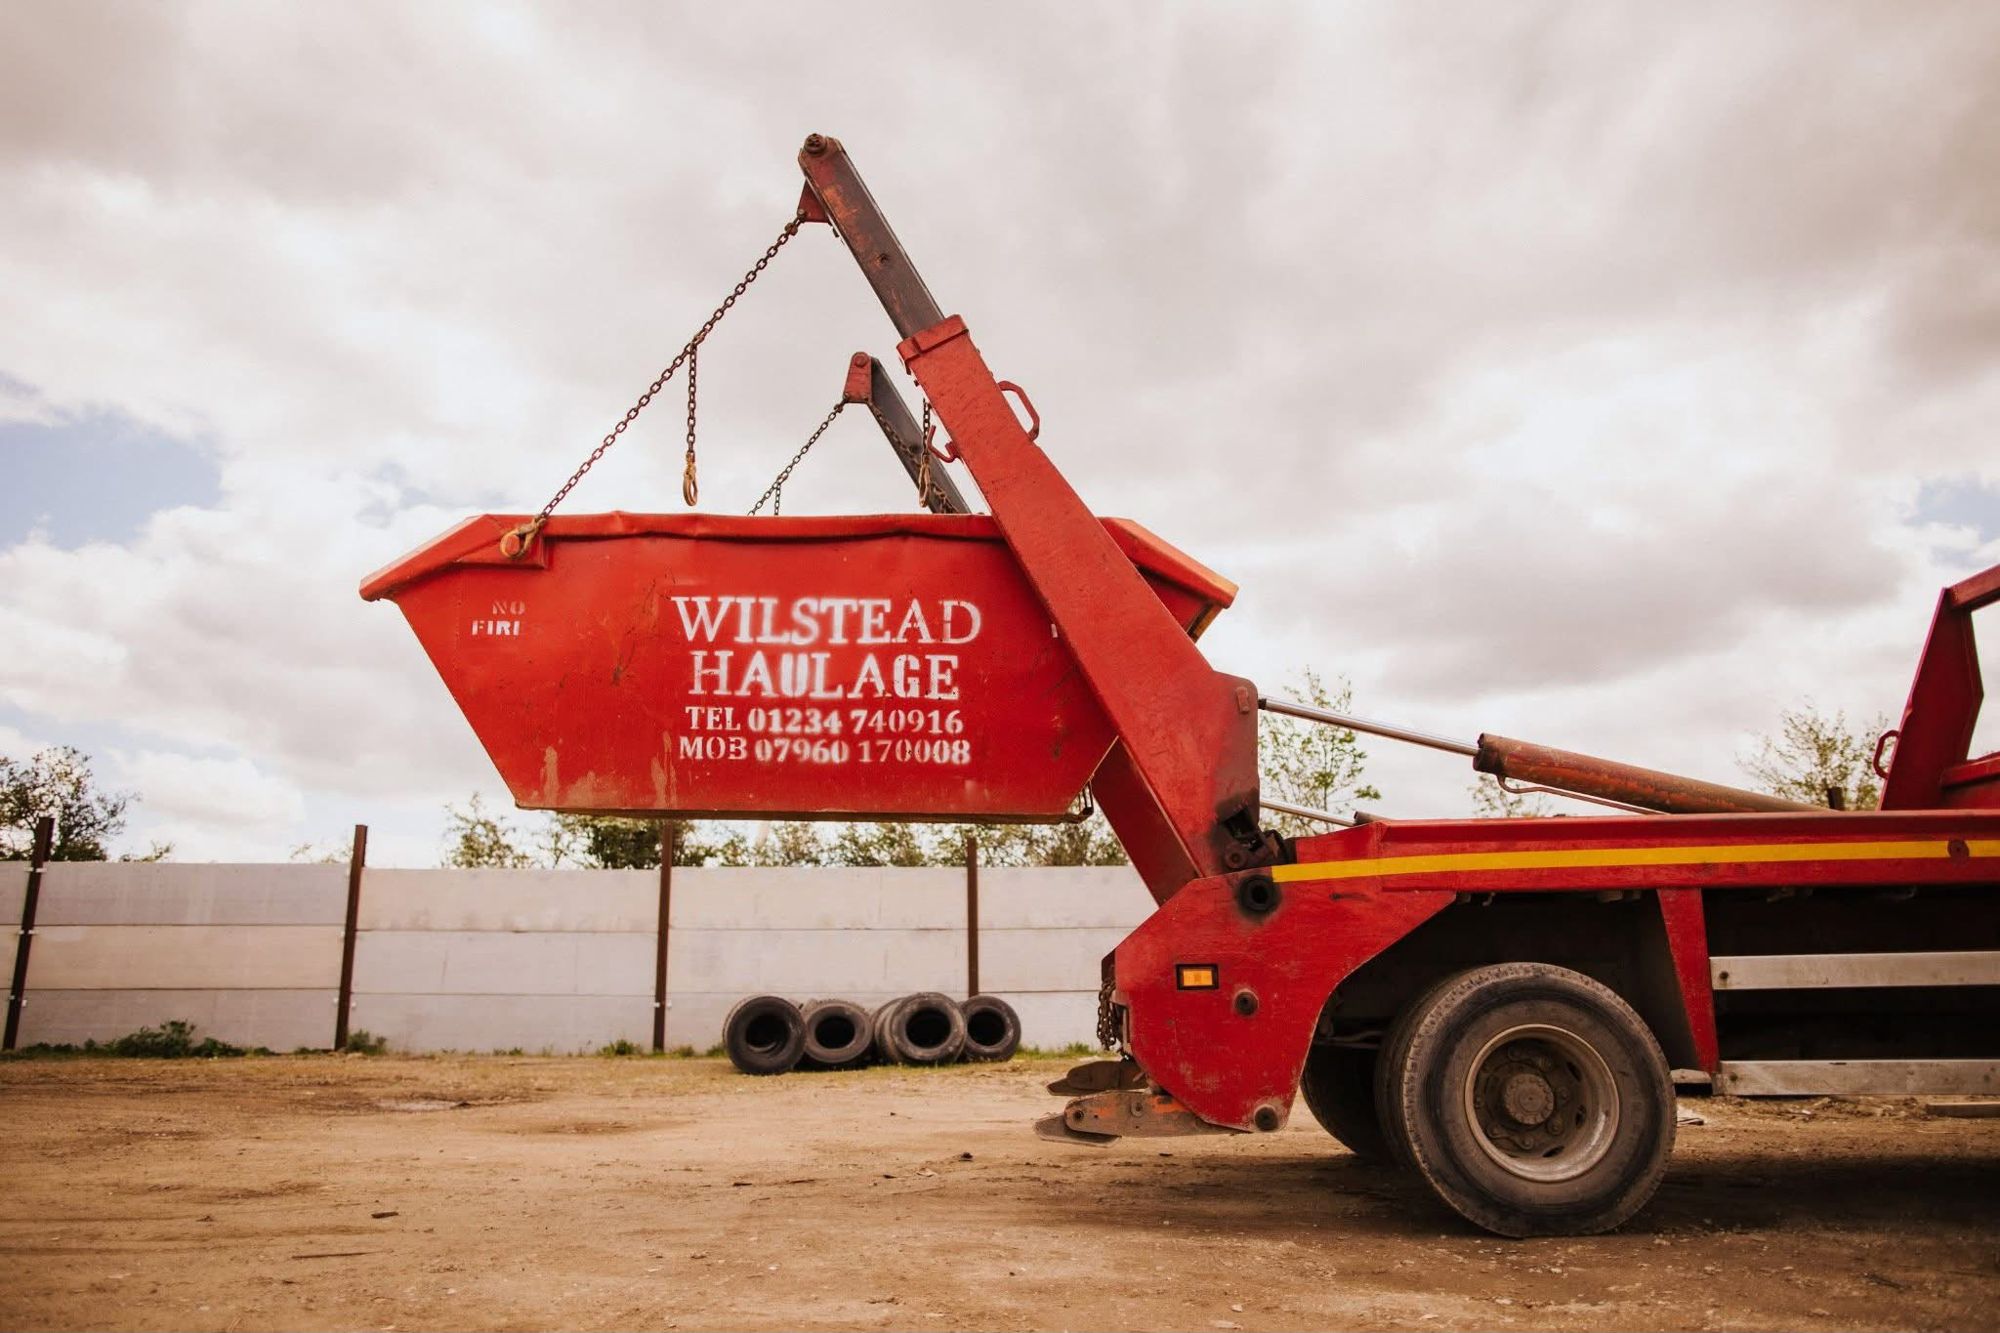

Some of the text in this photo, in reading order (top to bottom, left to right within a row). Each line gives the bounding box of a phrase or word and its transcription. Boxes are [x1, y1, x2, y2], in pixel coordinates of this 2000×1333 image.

[492, 601, 525, 615] NO
[671, 595, 982, 645] WILSTEAD
[688, 650, 960, 700] HAULAGE
[685, 706, 964, 735] TEL 01234 740916
[679, 736, 971, 765] MOB 07960 170008
